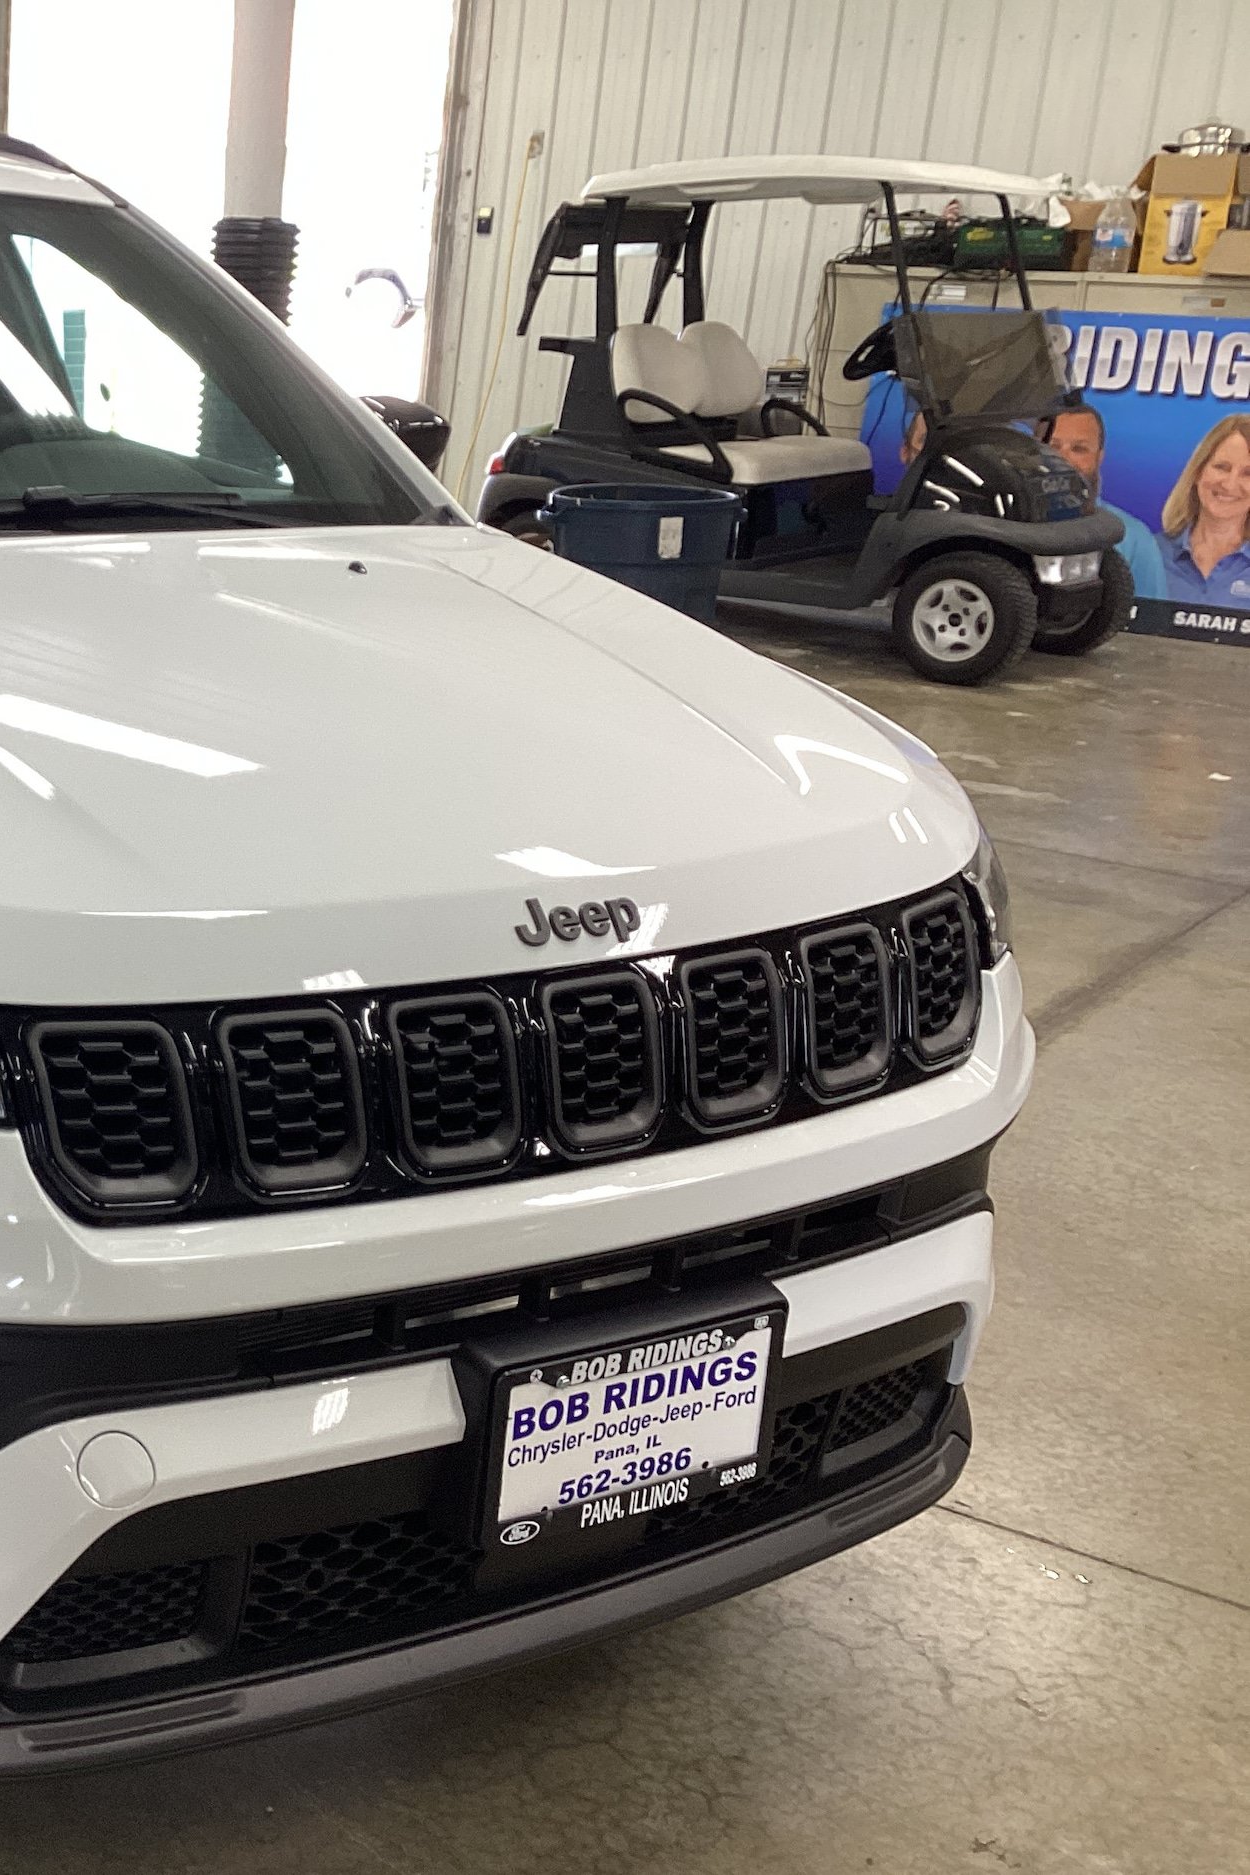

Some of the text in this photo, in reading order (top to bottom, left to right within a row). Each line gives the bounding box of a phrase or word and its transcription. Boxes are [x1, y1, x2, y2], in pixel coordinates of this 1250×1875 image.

[1173, 611, 1237, 632] SARAH
[514, 897, 641, 947] Jeep
[571, 1329, 724, 1385] BOB RIDINGS
[512, 1351, 757, 1441] BOB RIDINGS
[507, 1385, 757, 1467] Chrysler-Dodge-Jeep-Ford
[594, 1434, 662, 1463] Pana, IL
[559, 1447, 692, 1504] 562-3986
[580, 1477, 689, 1528] PANA, ILLINOIS
